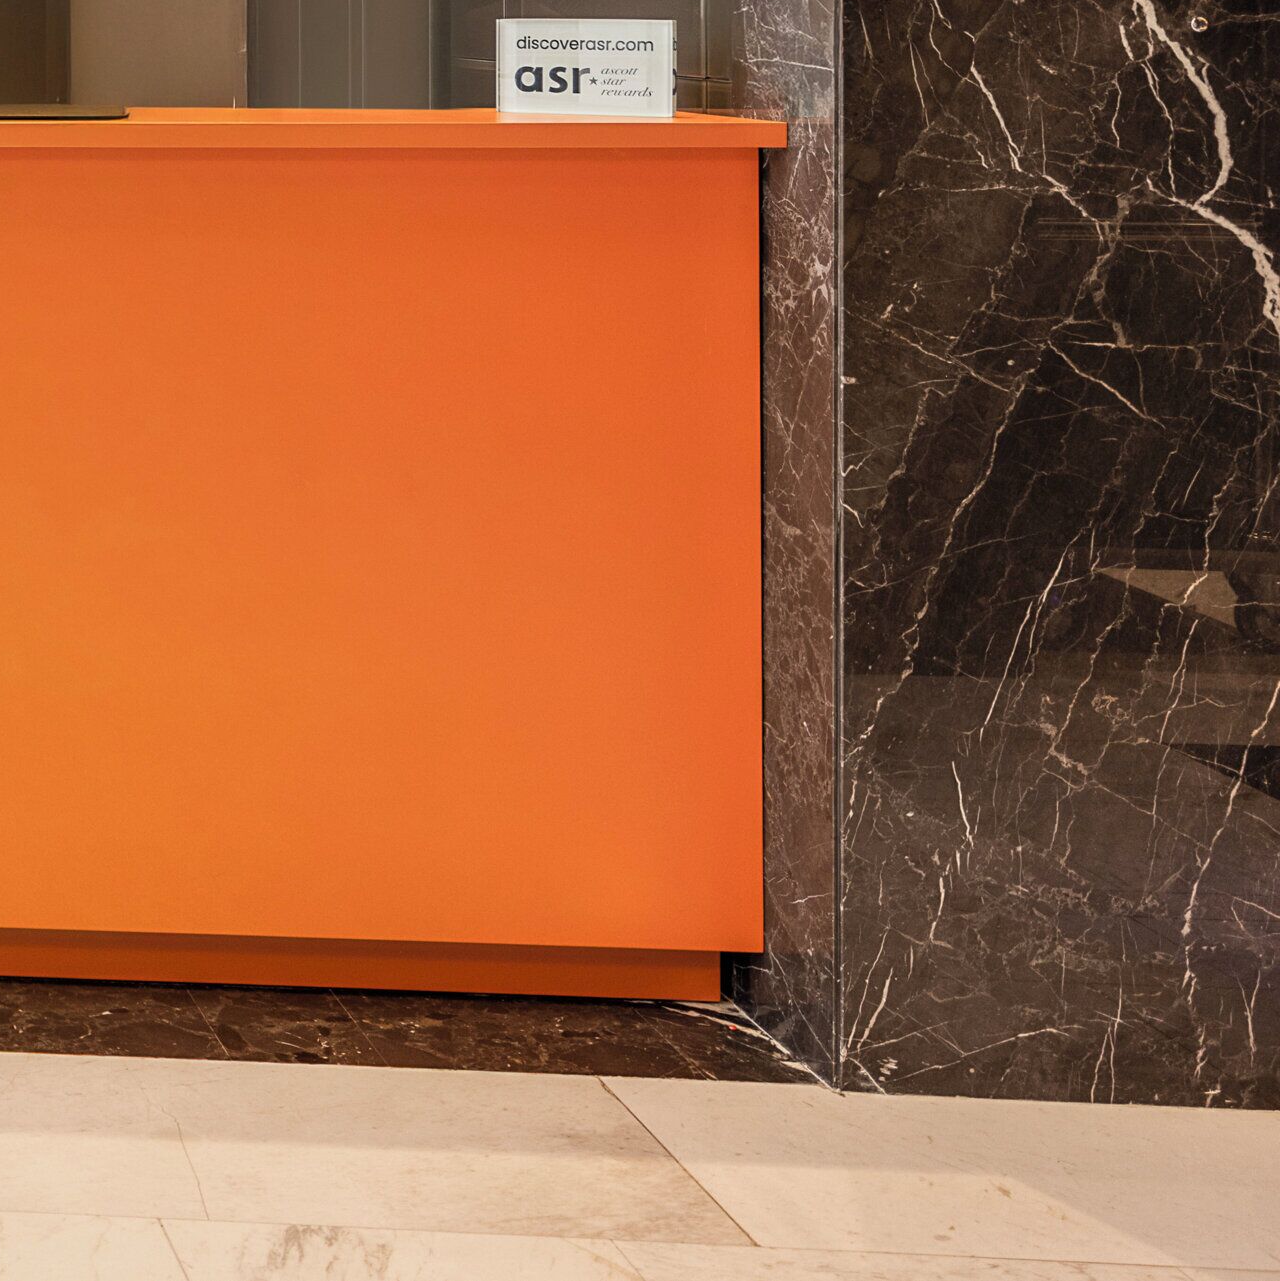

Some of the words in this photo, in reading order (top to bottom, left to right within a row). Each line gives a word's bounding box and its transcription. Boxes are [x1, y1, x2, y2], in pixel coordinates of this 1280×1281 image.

[516, 36, 654, 52] discoverasr.com
[600, 67, 639, 76] ascott
[514, 64, 590, 94] asr
[599, 78, 627, 86] star
[600, 86, 654, 97] rewards
